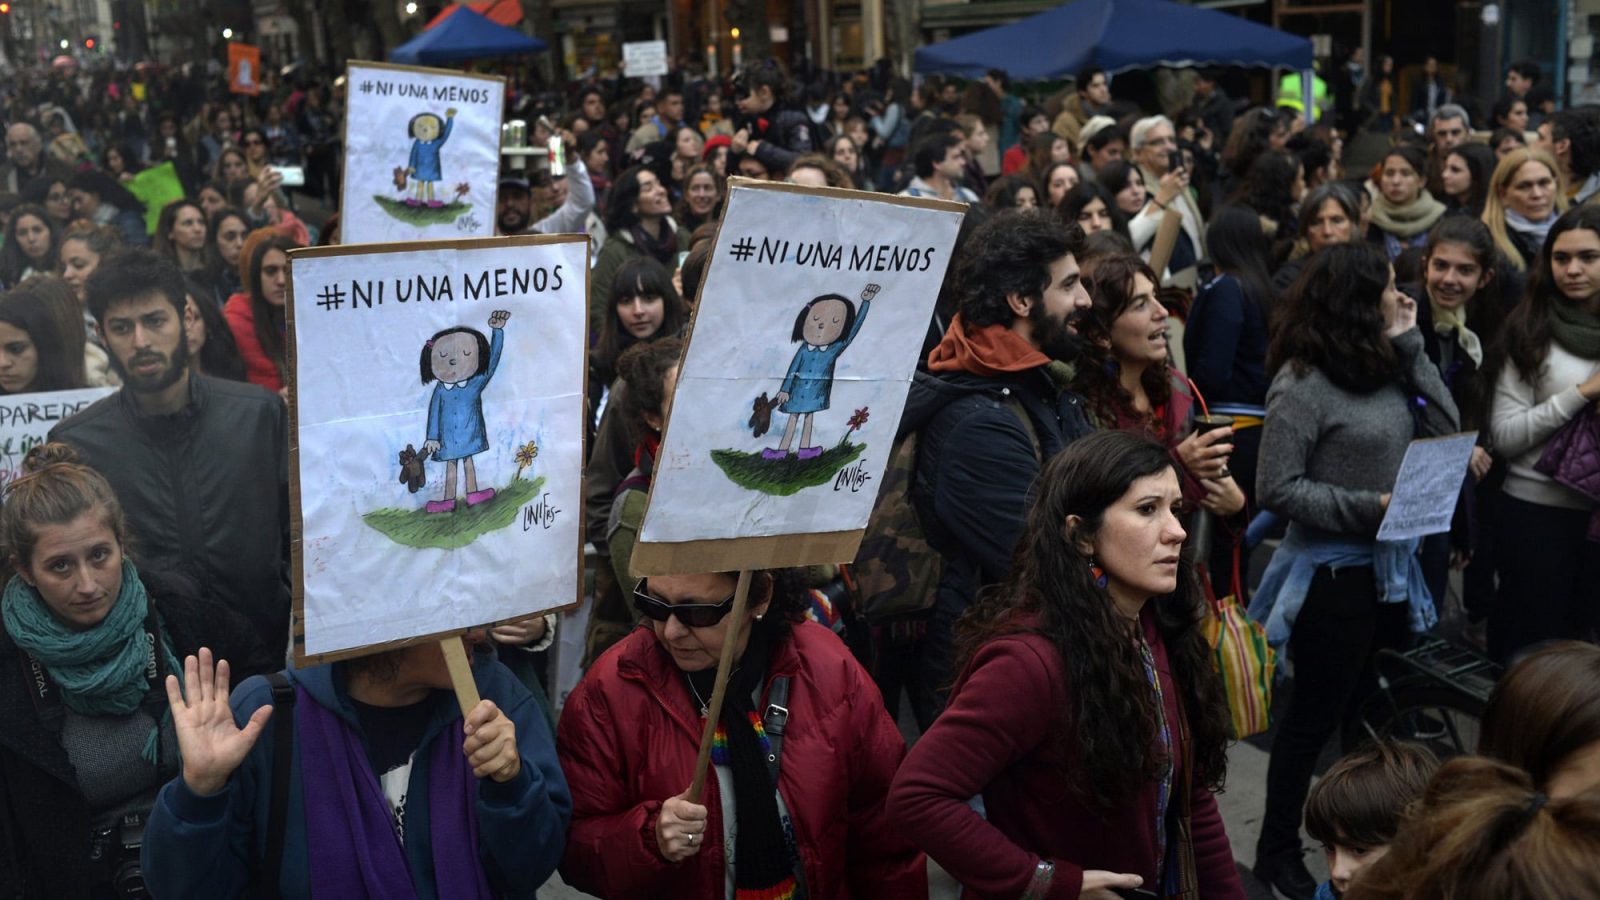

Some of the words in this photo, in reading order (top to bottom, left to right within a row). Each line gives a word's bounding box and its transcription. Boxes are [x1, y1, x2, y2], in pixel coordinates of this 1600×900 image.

[360, 80, 394, 96] #NI
[399, 83, 429, 100] UNA
[433, 86, 489, 104] MENOS
[729, 236, 789, 265] #NI
[795, 241, 841, 270] UNA
[848, 244, 935, 271] MENOS
[316, 280, 384, 310] #NI
[396, 275, 453, 303] UNA
[464, 265, 562, 301] MENOS
